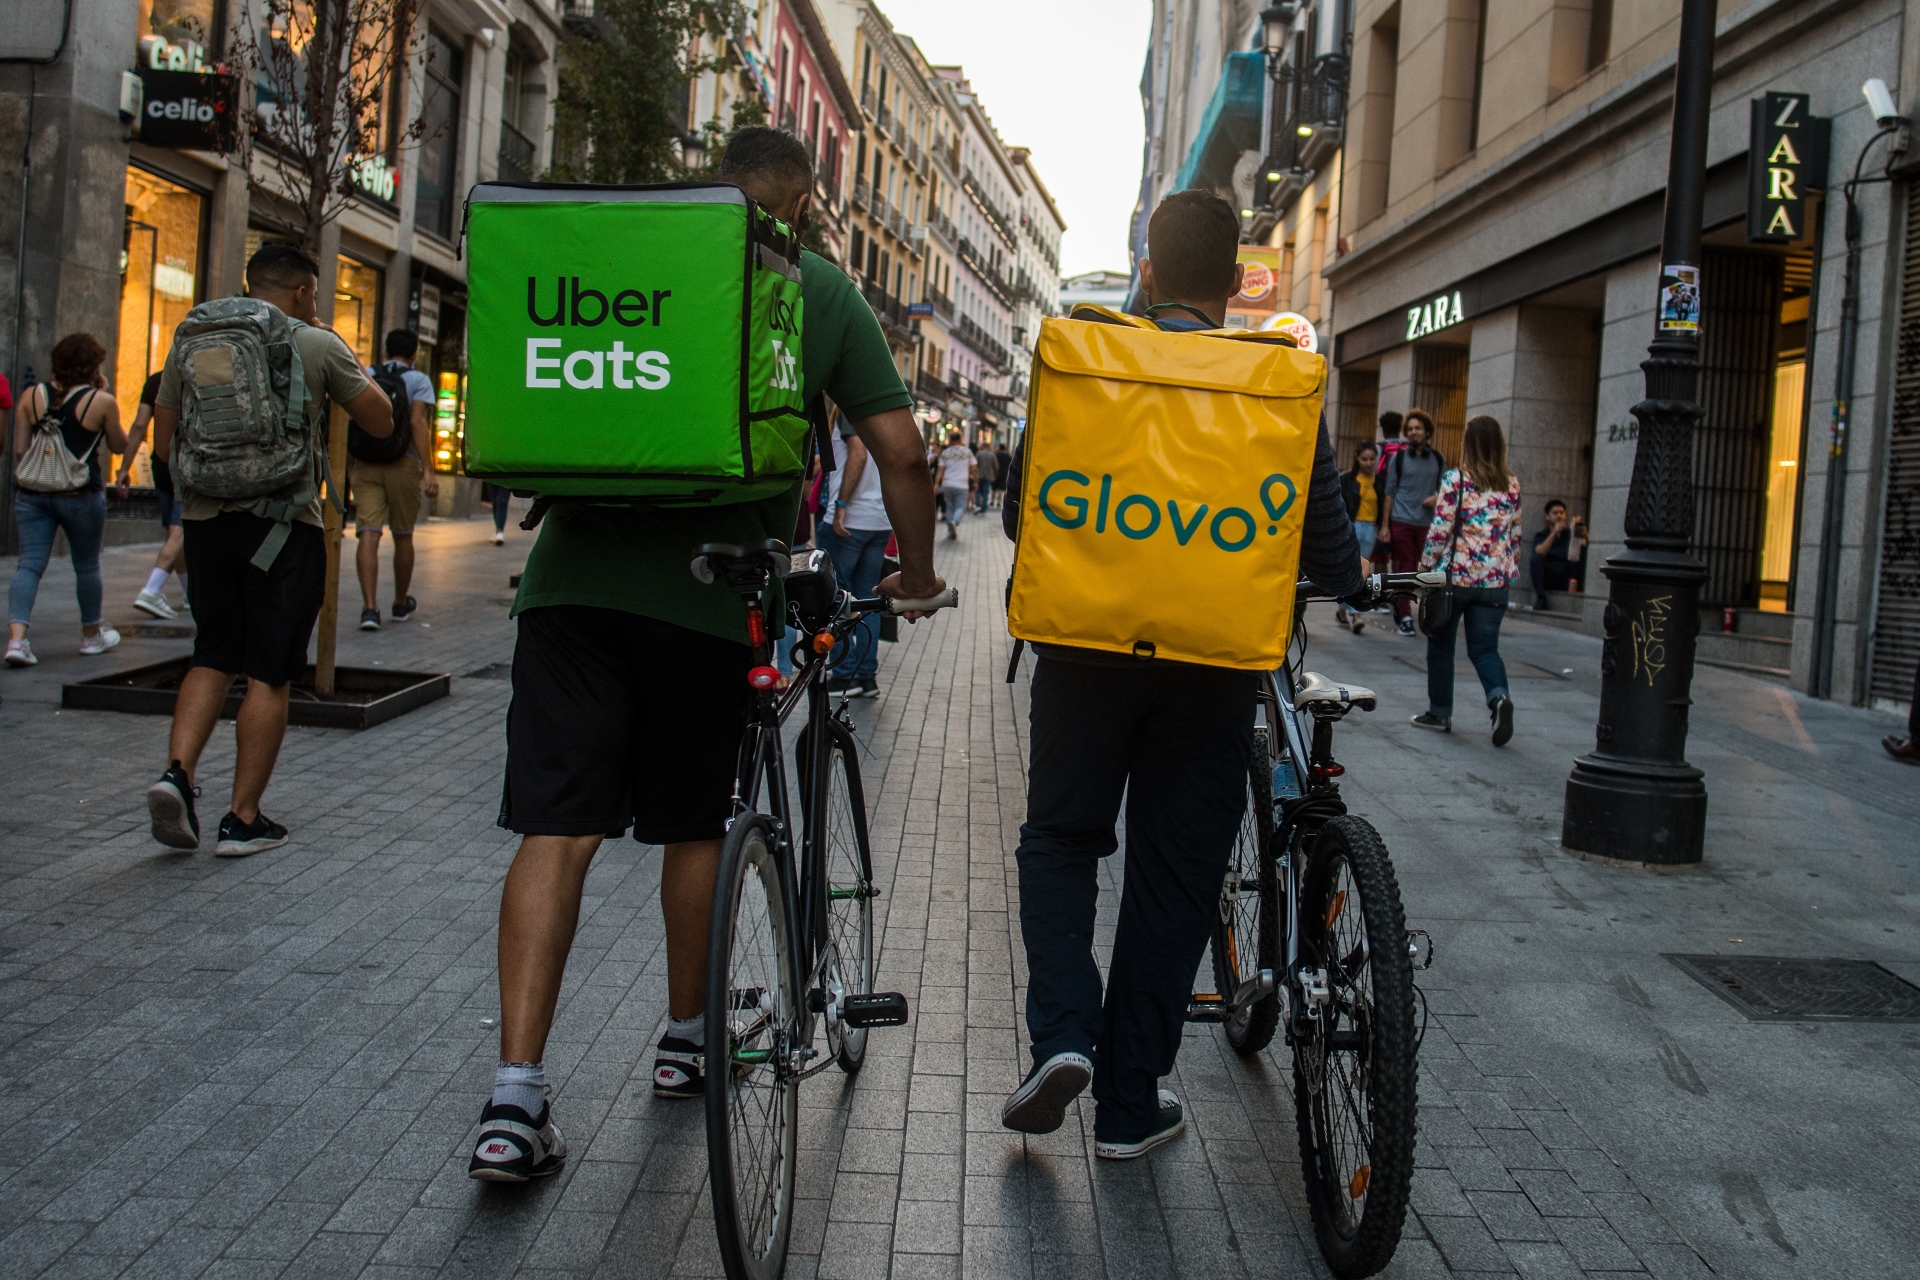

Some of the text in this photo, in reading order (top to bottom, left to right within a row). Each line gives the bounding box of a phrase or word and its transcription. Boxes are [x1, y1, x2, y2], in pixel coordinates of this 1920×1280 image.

[148, 35, 213, 74] celi
[1767, 97, 1800, 235] ZARA
[526, 276, 672, 328] Uber
[1406, 291, 1465, 341] ZARA
[526, 337, 672, 391] Eats
[1609, 421, 1638, 443] ZAR
[658, 1069, 677, 1079] NIKE
[484, 1143, 509, 1155] NIKE
